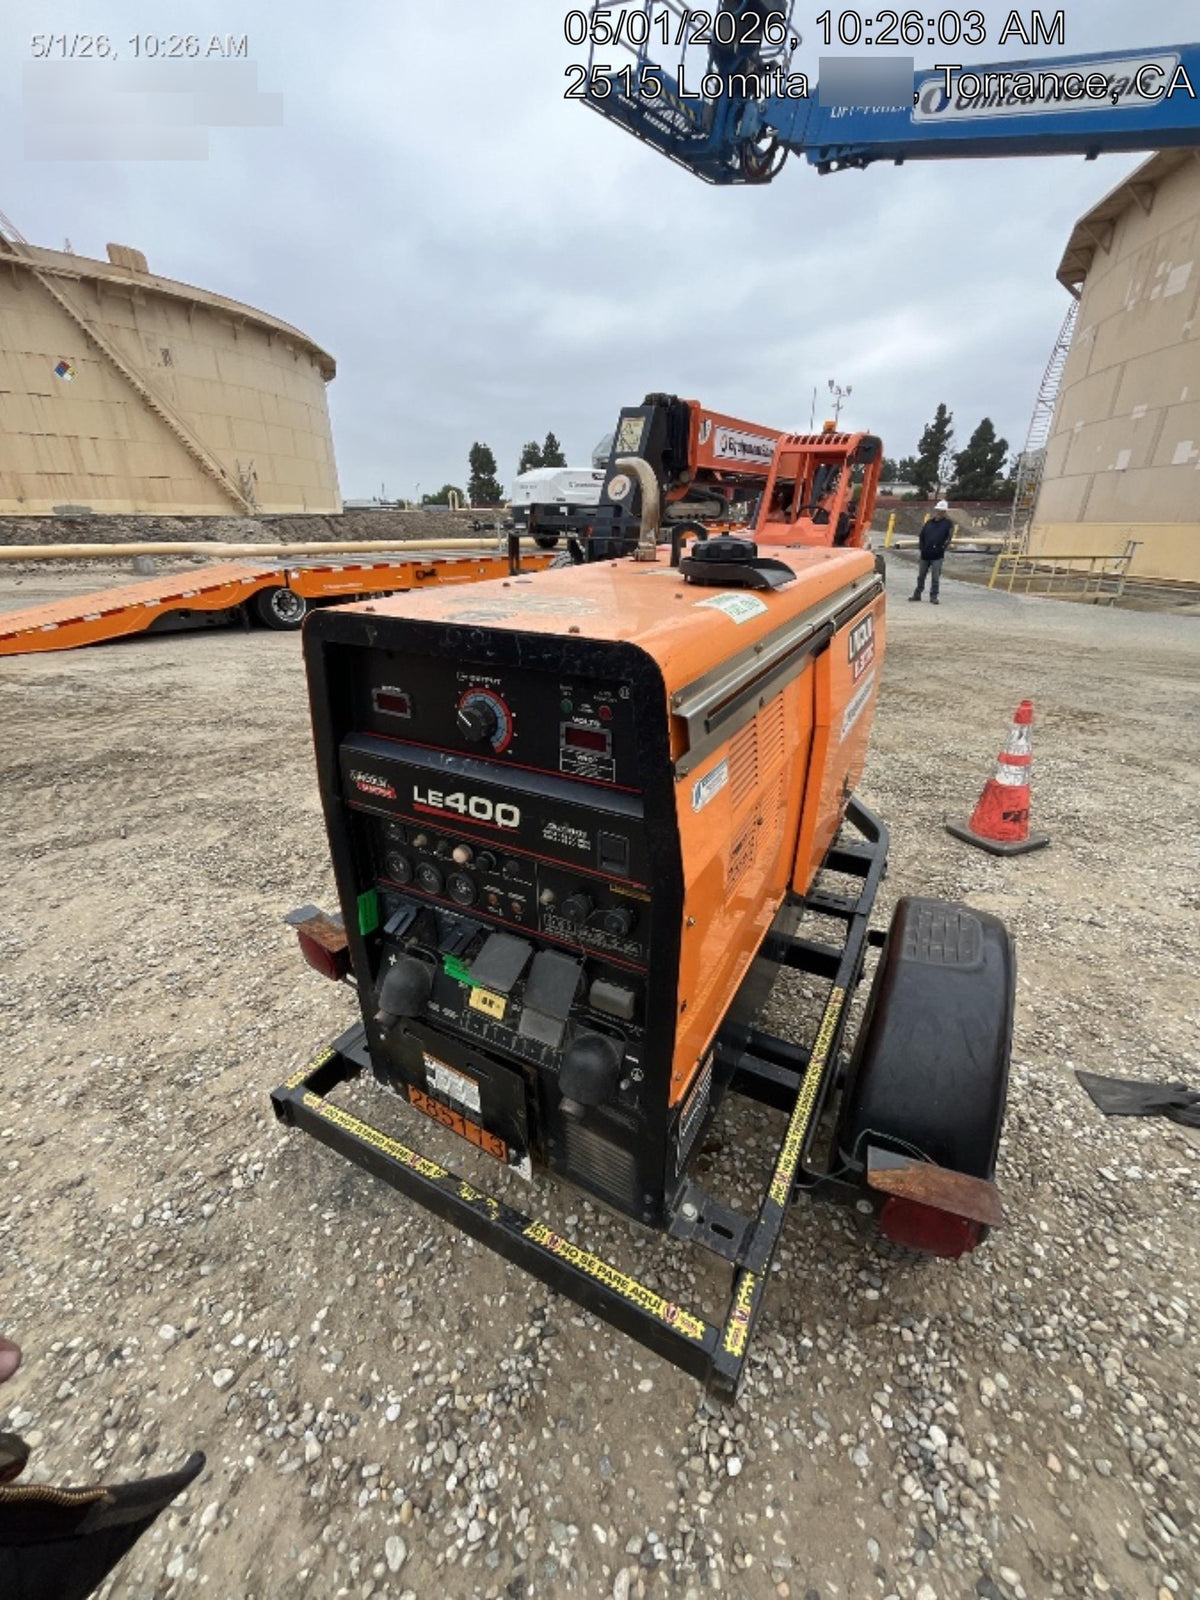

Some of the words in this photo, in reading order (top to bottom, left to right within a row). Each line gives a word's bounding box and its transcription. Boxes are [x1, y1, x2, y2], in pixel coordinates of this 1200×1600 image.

[413, 785, 521, 828] LE400
[354, 1124, 385, 1146] STAND
[411, 1086, 504, 1159] 285113
[560, 1244, 579, 1259] NO
[578, 1254, 596, 1270] SE
[597, 1265, 630, 1289] PARE
[629, 1286, 662, 1311] AQUI
